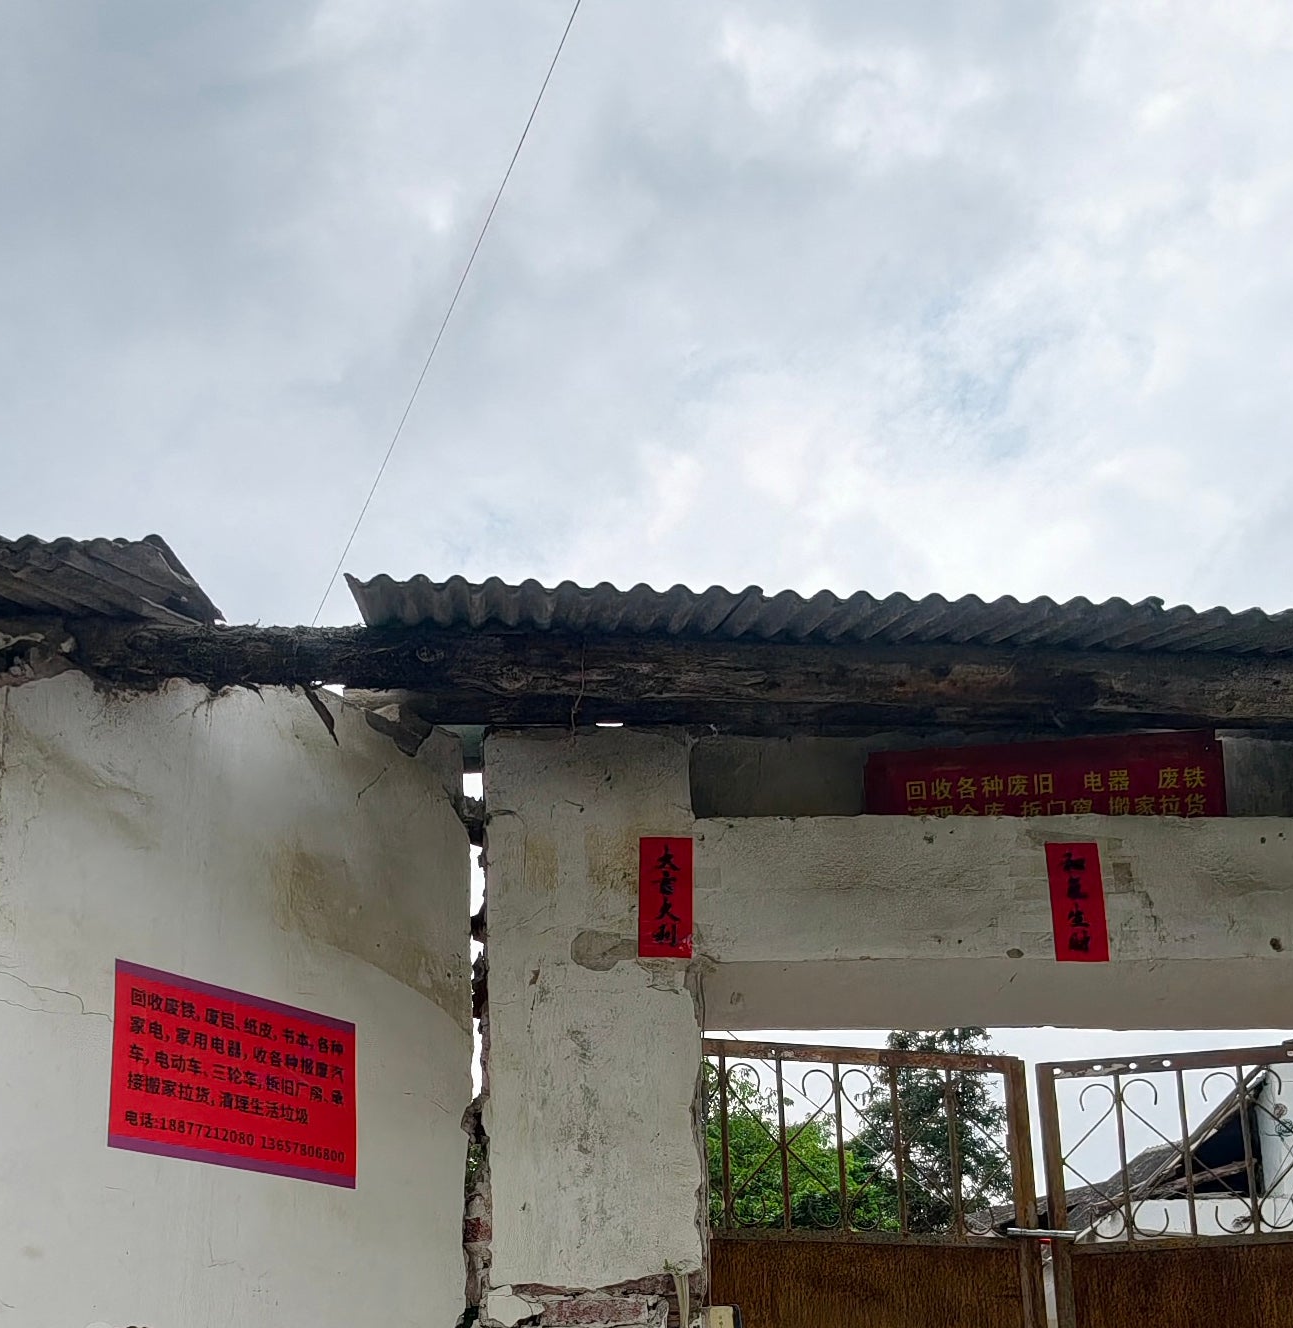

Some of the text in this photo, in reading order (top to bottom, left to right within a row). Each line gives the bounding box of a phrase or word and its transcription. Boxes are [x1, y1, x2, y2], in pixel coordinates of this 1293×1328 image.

[906, 765, 1206, 800] 回收各种废旧 电器 废铁
